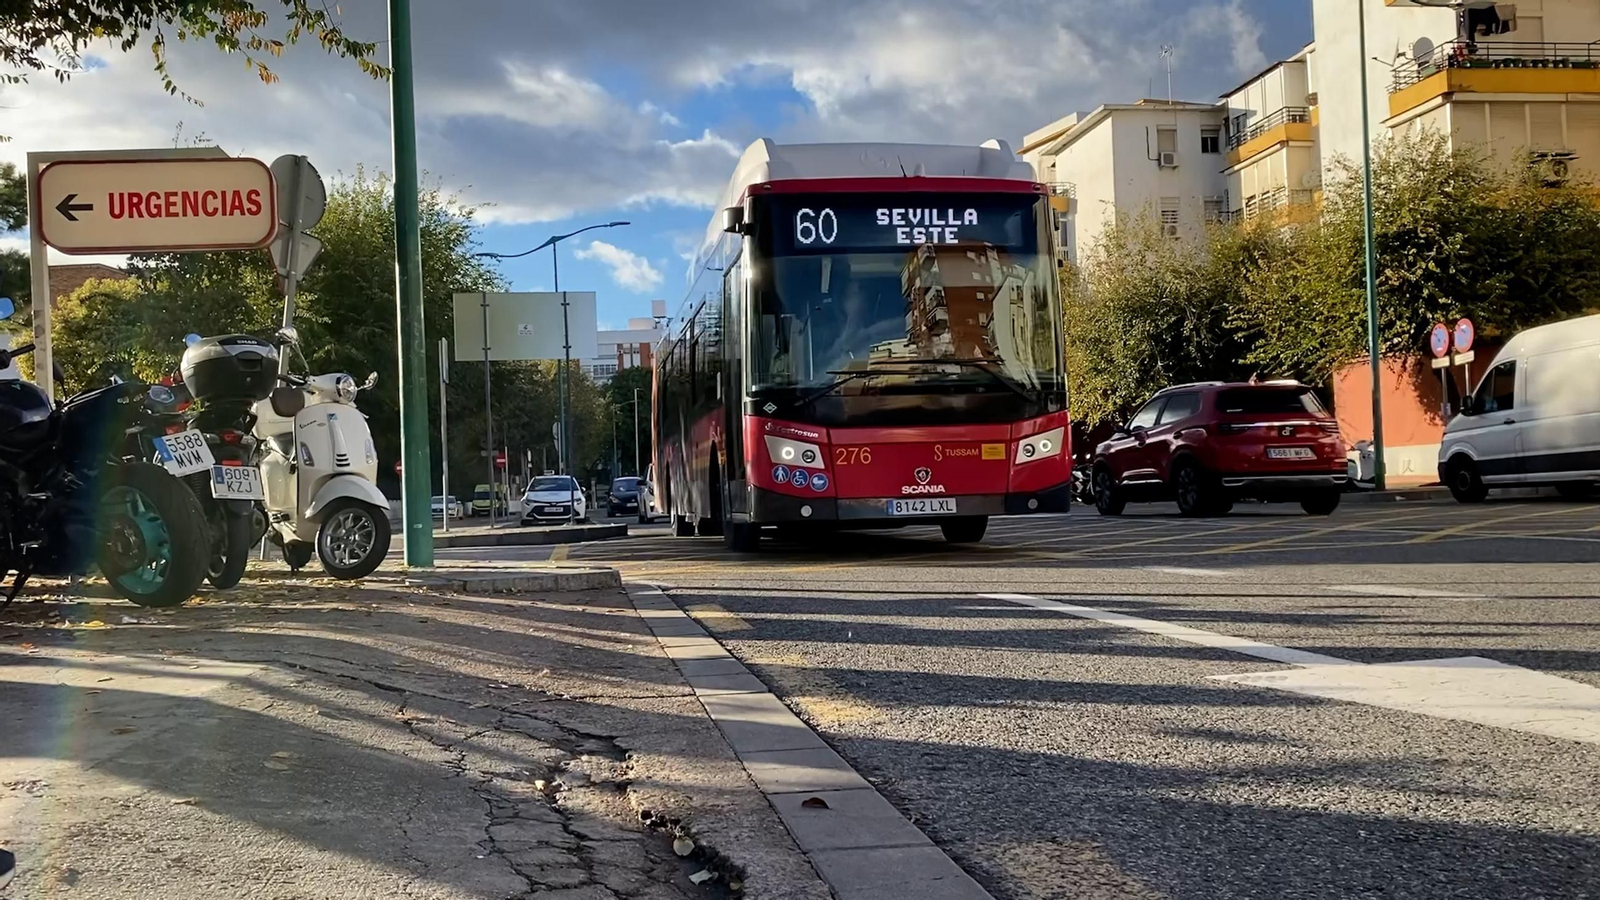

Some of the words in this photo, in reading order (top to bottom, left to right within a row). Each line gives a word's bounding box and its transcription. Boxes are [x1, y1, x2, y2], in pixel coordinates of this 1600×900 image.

[108, 189, 262, 219] URGENCIAS
[876, 208, 978, 225] SEVILLA
[796, 208, 838, 243] 60
[896, 227, 959, 243] ESTE
[165, 433, 203, 453] 5588
[173, 449, 204, 469] MVM
[836, 447, 872, 465] 276
[945, 448, 979, 456] TUSSAM
[225, 467, 258, 481] 6091
[227, 480, 252, 493] KZJ
[901, 484, 946, 494] SCANIA
[895, 500, 926, 513] 8142
[930, 499, 953, 512] LXL
